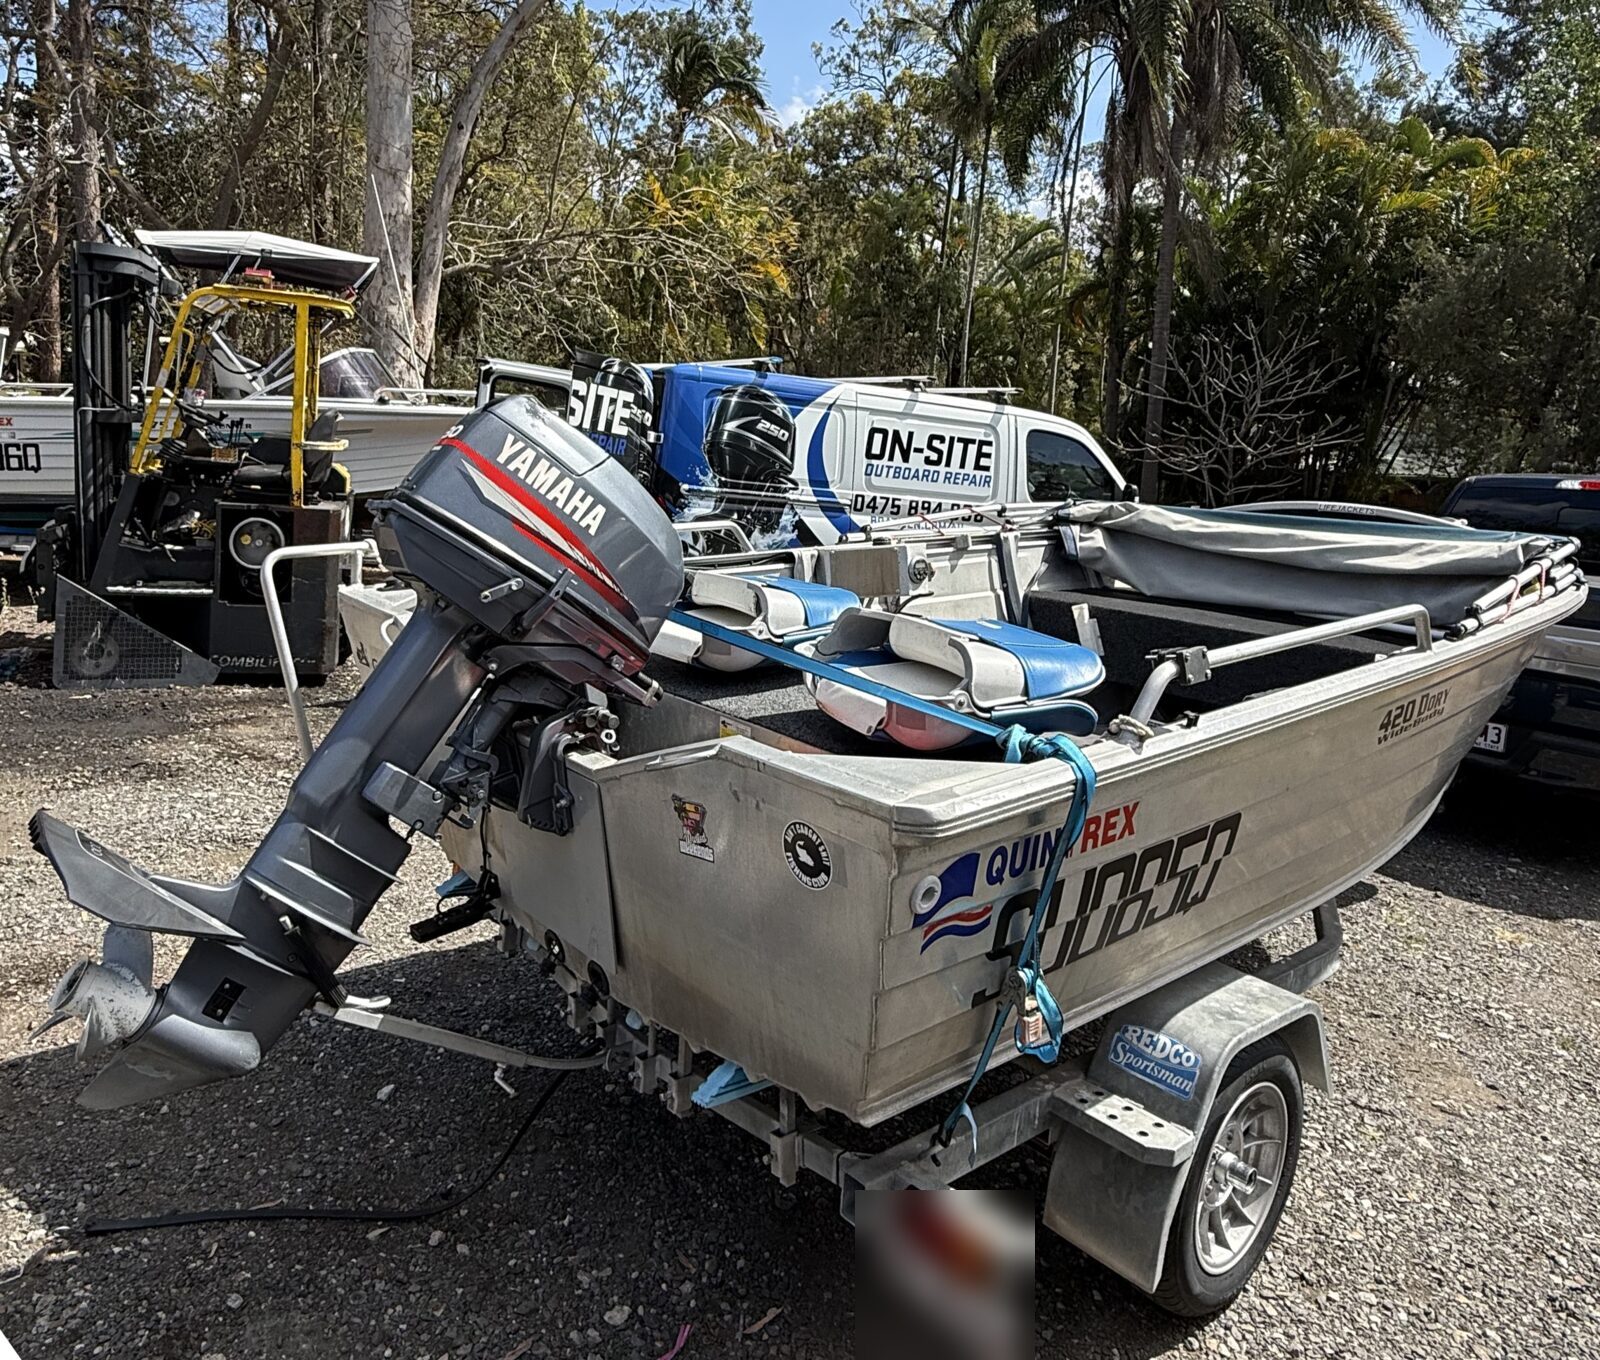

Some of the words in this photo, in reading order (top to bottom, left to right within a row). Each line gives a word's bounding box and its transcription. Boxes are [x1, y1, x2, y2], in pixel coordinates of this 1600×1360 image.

[756, 419, 789, 442] 250
[865, 427, 993, 472] ON-SITE
[496, 433, 607, 536] YAMAHA
[864, 463, 941, 483] OUTBOARD
[942, 472, 992, 488] REPAIR
[853, 494, 902, 516] 0475
[1318, 503, 1376, 515] LIFEJACKETS
[1379, 699, 1417, 733] 420
[986, 801, 1140, 886] QUINREX
[811, 872, 829, 888] CLUB
[1111, 1041, 1193, 1092] Sportsman
